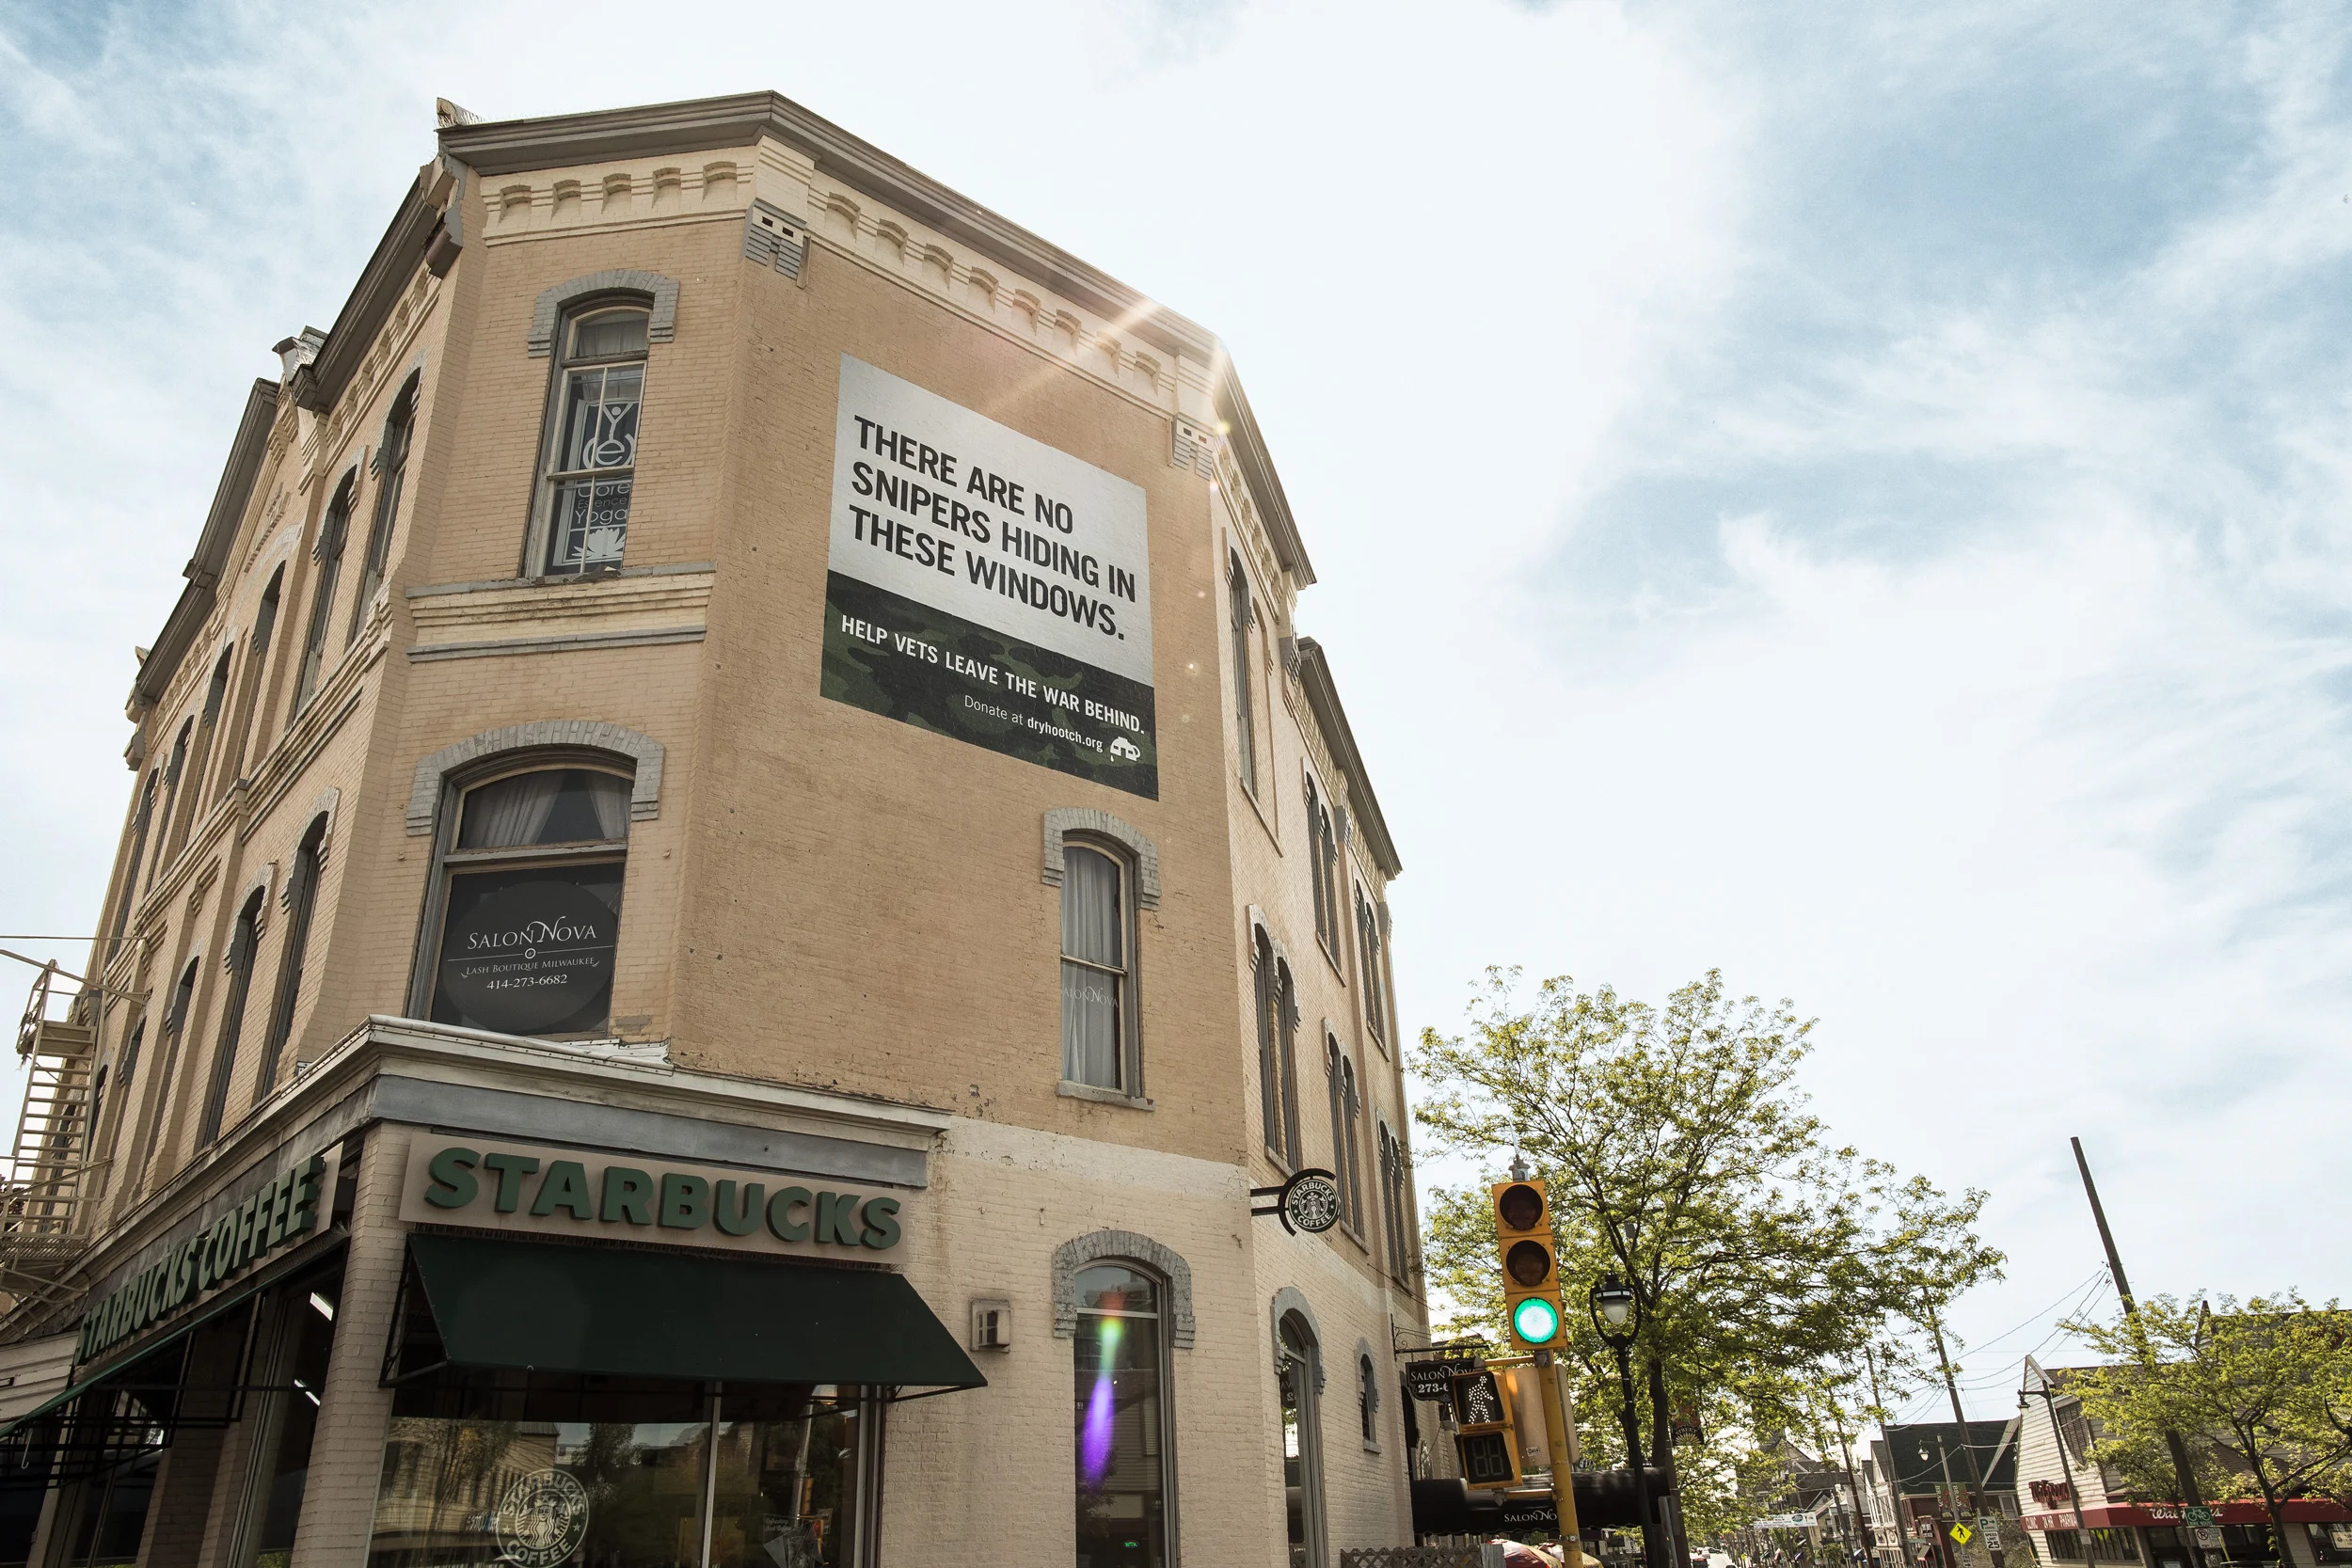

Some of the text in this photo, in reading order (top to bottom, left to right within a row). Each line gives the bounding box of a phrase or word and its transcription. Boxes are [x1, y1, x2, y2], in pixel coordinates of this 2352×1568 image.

[854, 415, 1073, 534] THERE ARE NO
[578, 483, 630, 498] Core
[578, 497, 628, 509] Esence
[575, 508, 628, 526] Yoga
[850, 461, 1136, 603] SNIPERS HIDING IN
[849, 504, 1125, 640] THESE WINDOWS.
[841, 614, 1145, 735] HELP VETS LEAVE THE WAR BEHIND.
[964, 694, 1104, 752] Donate at dryhootch.org
[468, 915, 597, 950] SALON NOVA
[466, 957, 595, 975] LASH BOUTIQUE MILWAUKEE
[486, 974, 567, 990] 414-273-6682
[1086, 986, 1119, 1007] NOVA
[424, 1147, 901, 1250] STARBUCKS
[1292, 1181, 1334, 1205] STARBUCKS
[1297, 1212, 1331, 1227] COFFEE
[74, 1156, 326, 1366] STARBUCKS COFFEE
[1411, 1370, 1445, 1382] SALON
[503, 1473, 585, 1516] STARBUCKS
[1503, 1509, 1558, 1522] SALON NO
[507, 1539, 572, 1565] COFFEE
[1987, 1541, 2000, 1549] 25
